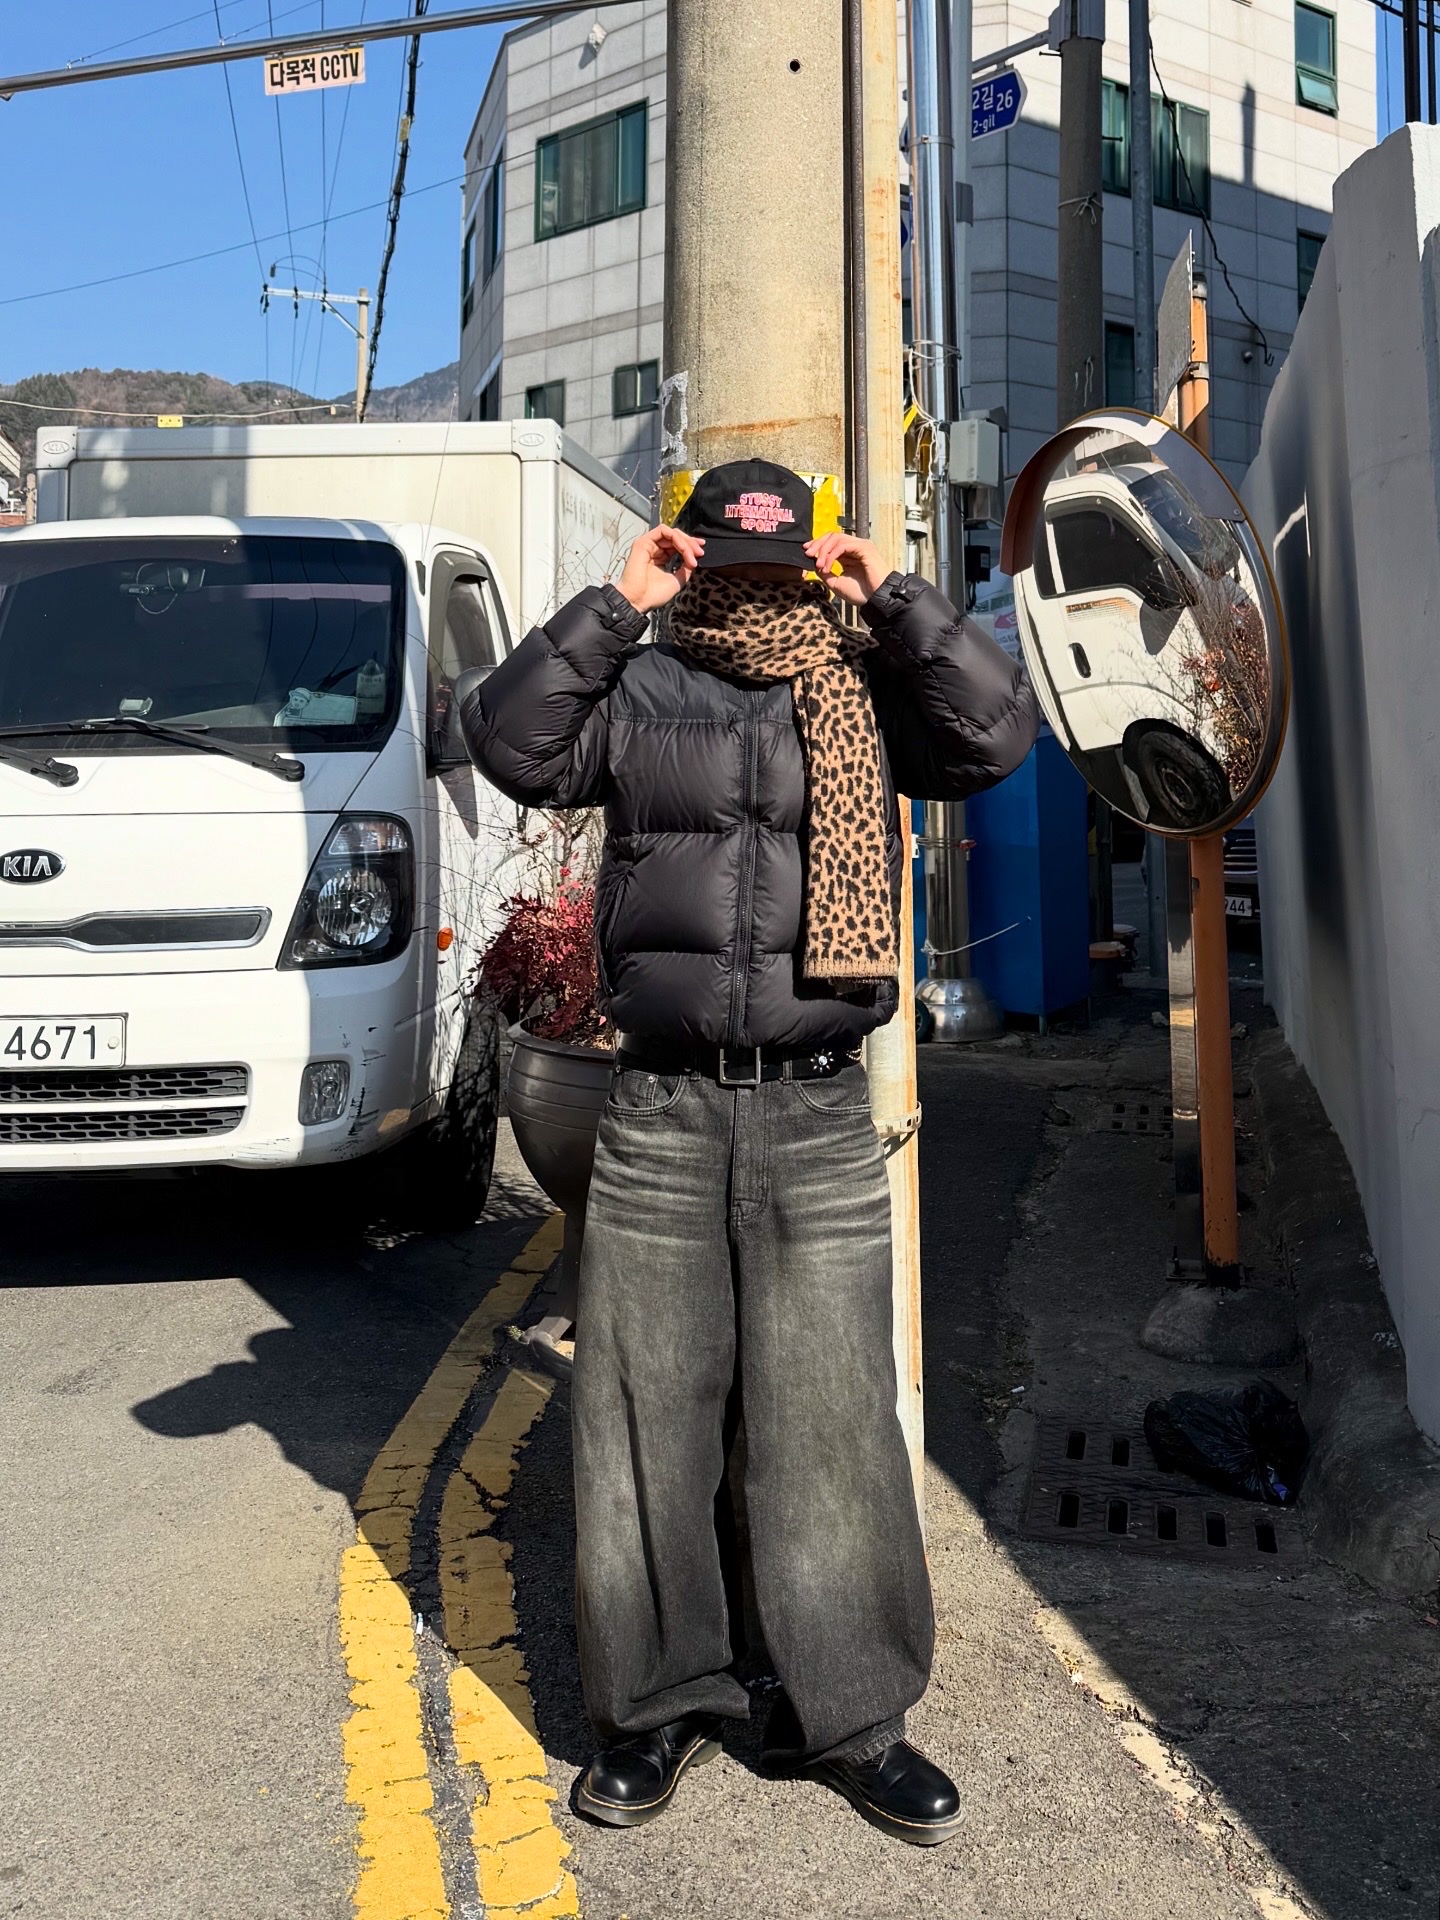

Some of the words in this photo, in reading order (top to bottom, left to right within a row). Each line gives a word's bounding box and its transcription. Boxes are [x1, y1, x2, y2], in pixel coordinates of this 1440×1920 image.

[270, 57, 316, 87] 다목적
[320, 52, 359, 81] CCTV
[972, 84, 994, 111] 2길
[996, 89, 1014, 112] 26
[973, 114, 995, 134] 2-gil
[740, 493, 783, 507] STUSSY
[724, 504, 796, 523] INTERNATIONAL
[740, 518, 779, 533] SPORT
[3, 855, 53, 877] KIA
[4, 1025, 96, 1061] 4671
